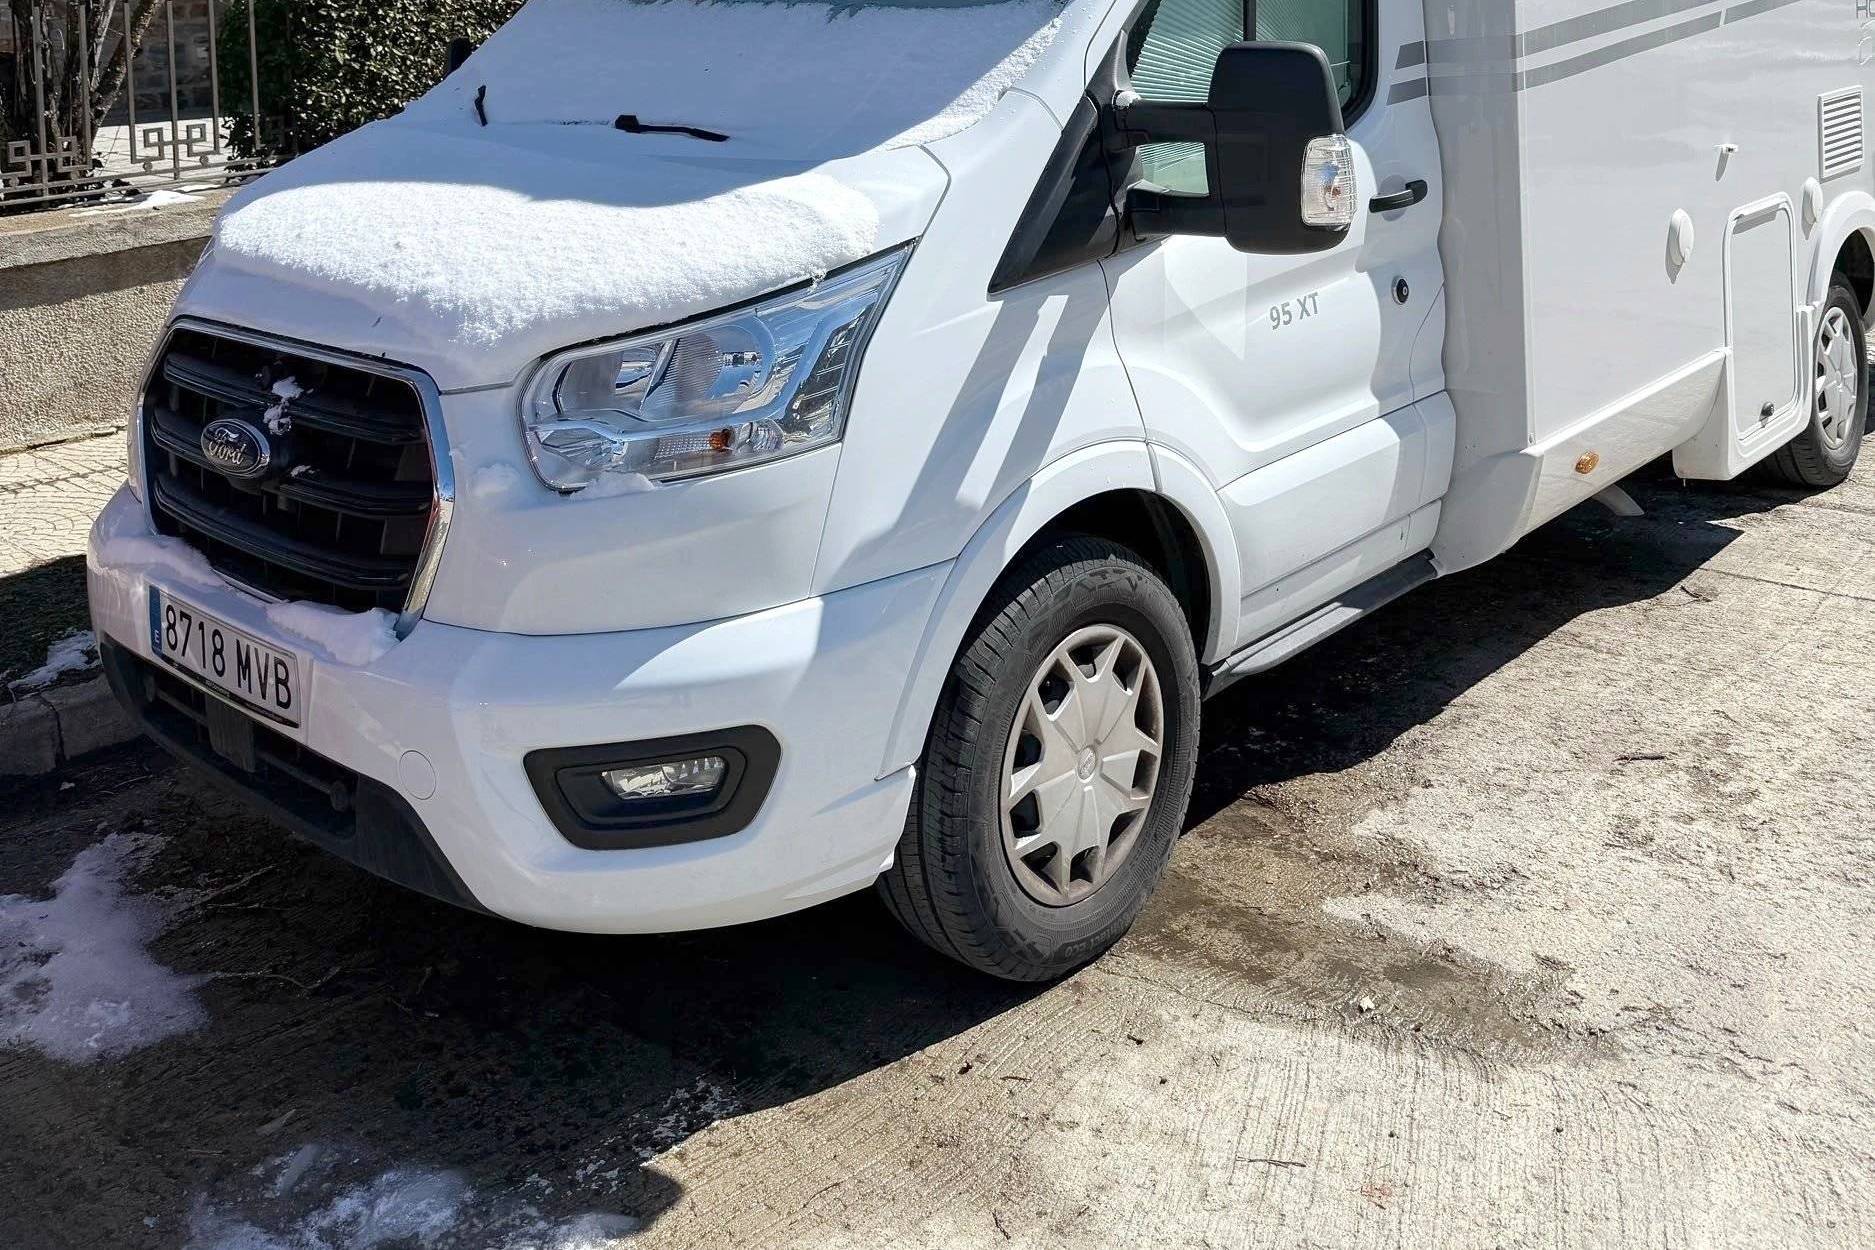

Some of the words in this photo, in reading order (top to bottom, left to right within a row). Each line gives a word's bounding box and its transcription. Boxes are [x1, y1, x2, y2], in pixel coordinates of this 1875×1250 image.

[1270, 302, 1292, 330] 95
[1296, 291, 1318, 320] XT
[208, 427, 247, 465] Ford
[166, 604, 226, 678] 8718
[236, 638, 292, 710] MVB
